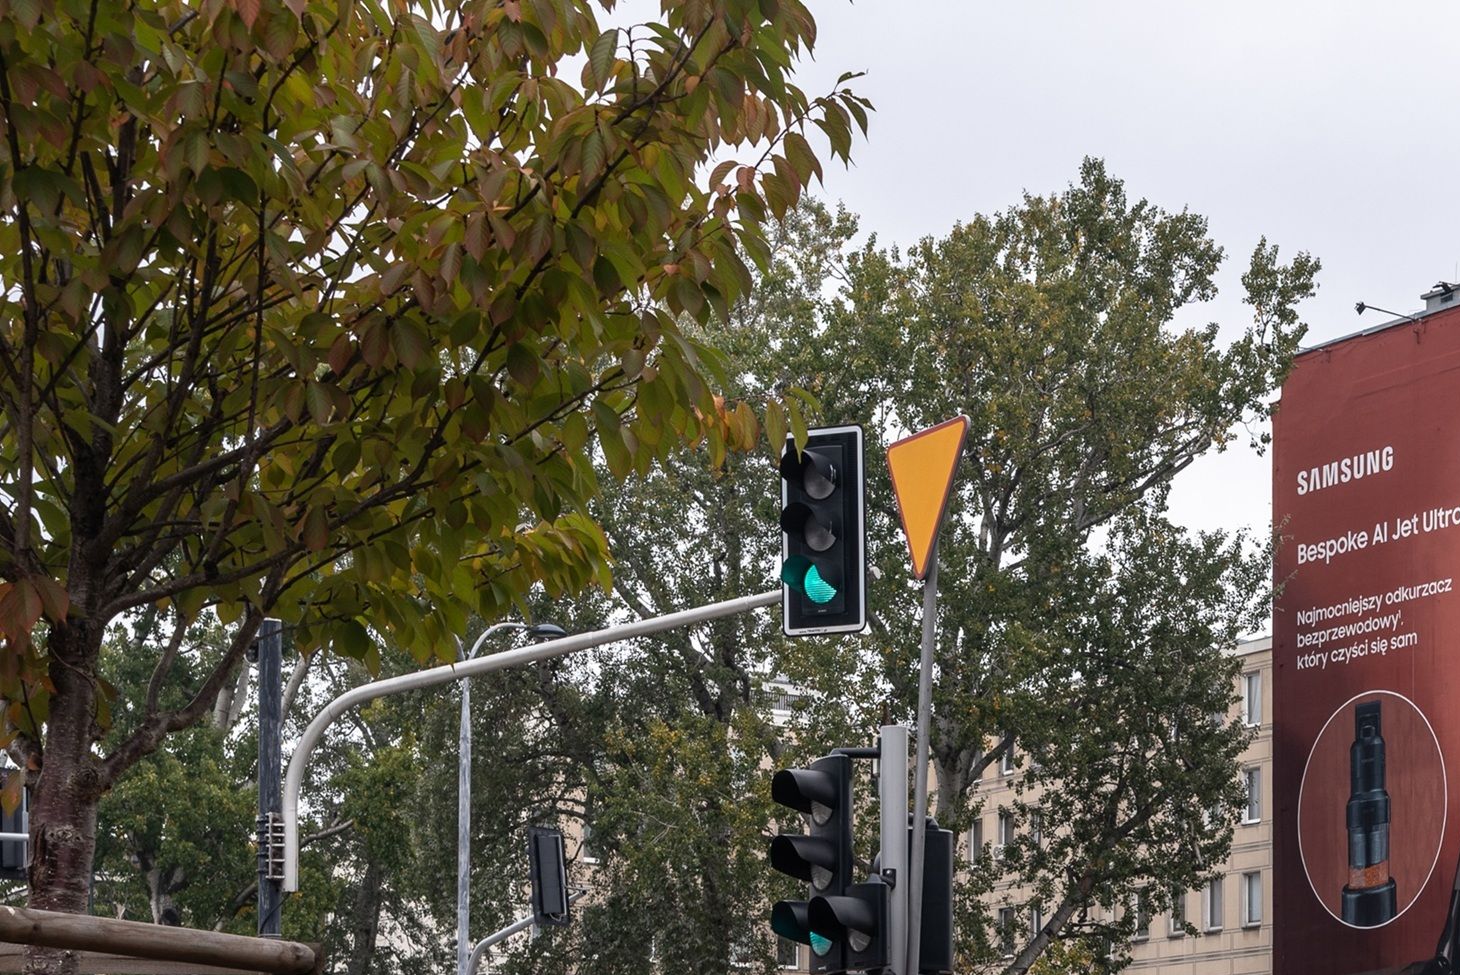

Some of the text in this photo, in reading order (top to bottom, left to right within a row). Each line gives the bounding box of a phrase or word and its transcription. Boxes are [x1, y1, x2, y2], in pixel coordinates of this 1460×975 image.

[1297, 446, 1394, 496] SAMSUNG
[1297, 533, 1368, 565] Bespoke
[1373, 523, 1388, 545] AI
[1392, 514, 1419, 541] Jet
[1297, 578, 1452, 627] Najmocniejszy odkurzacz
[1297, 632, 1418, 670] który czyści się sam
